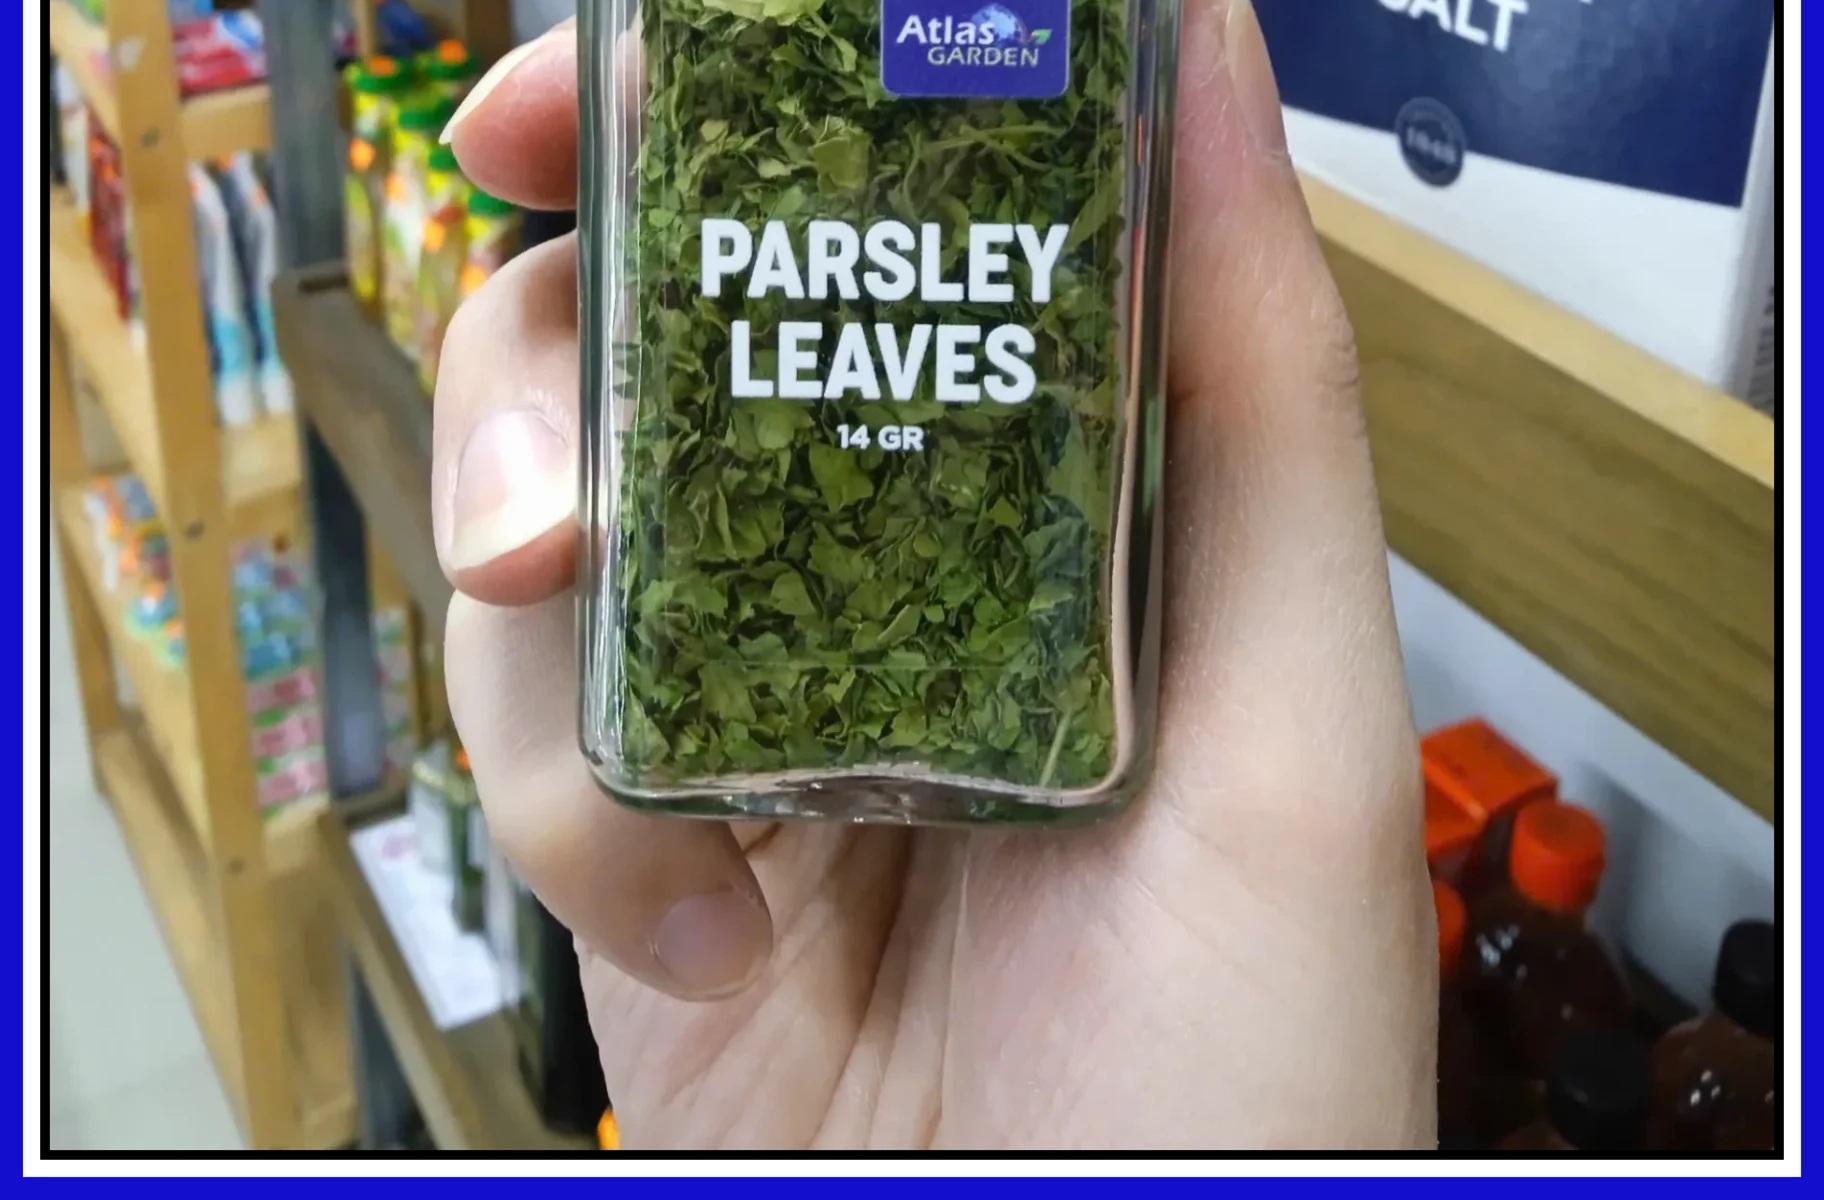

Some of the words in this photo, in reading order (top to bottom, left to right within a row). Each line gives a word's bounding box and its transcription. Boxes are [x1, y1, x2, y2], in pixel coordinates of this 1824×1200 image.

[897, 15, 995, 45] Atlas
[927, 46, 1040, 67] GARDEN
[701, 218, 1069, 303] PARSLEY
[730, 320, 1037, 404] LEAVES
[836, 423, 871, 450] 14
[877, 424, 925, 452] GR
